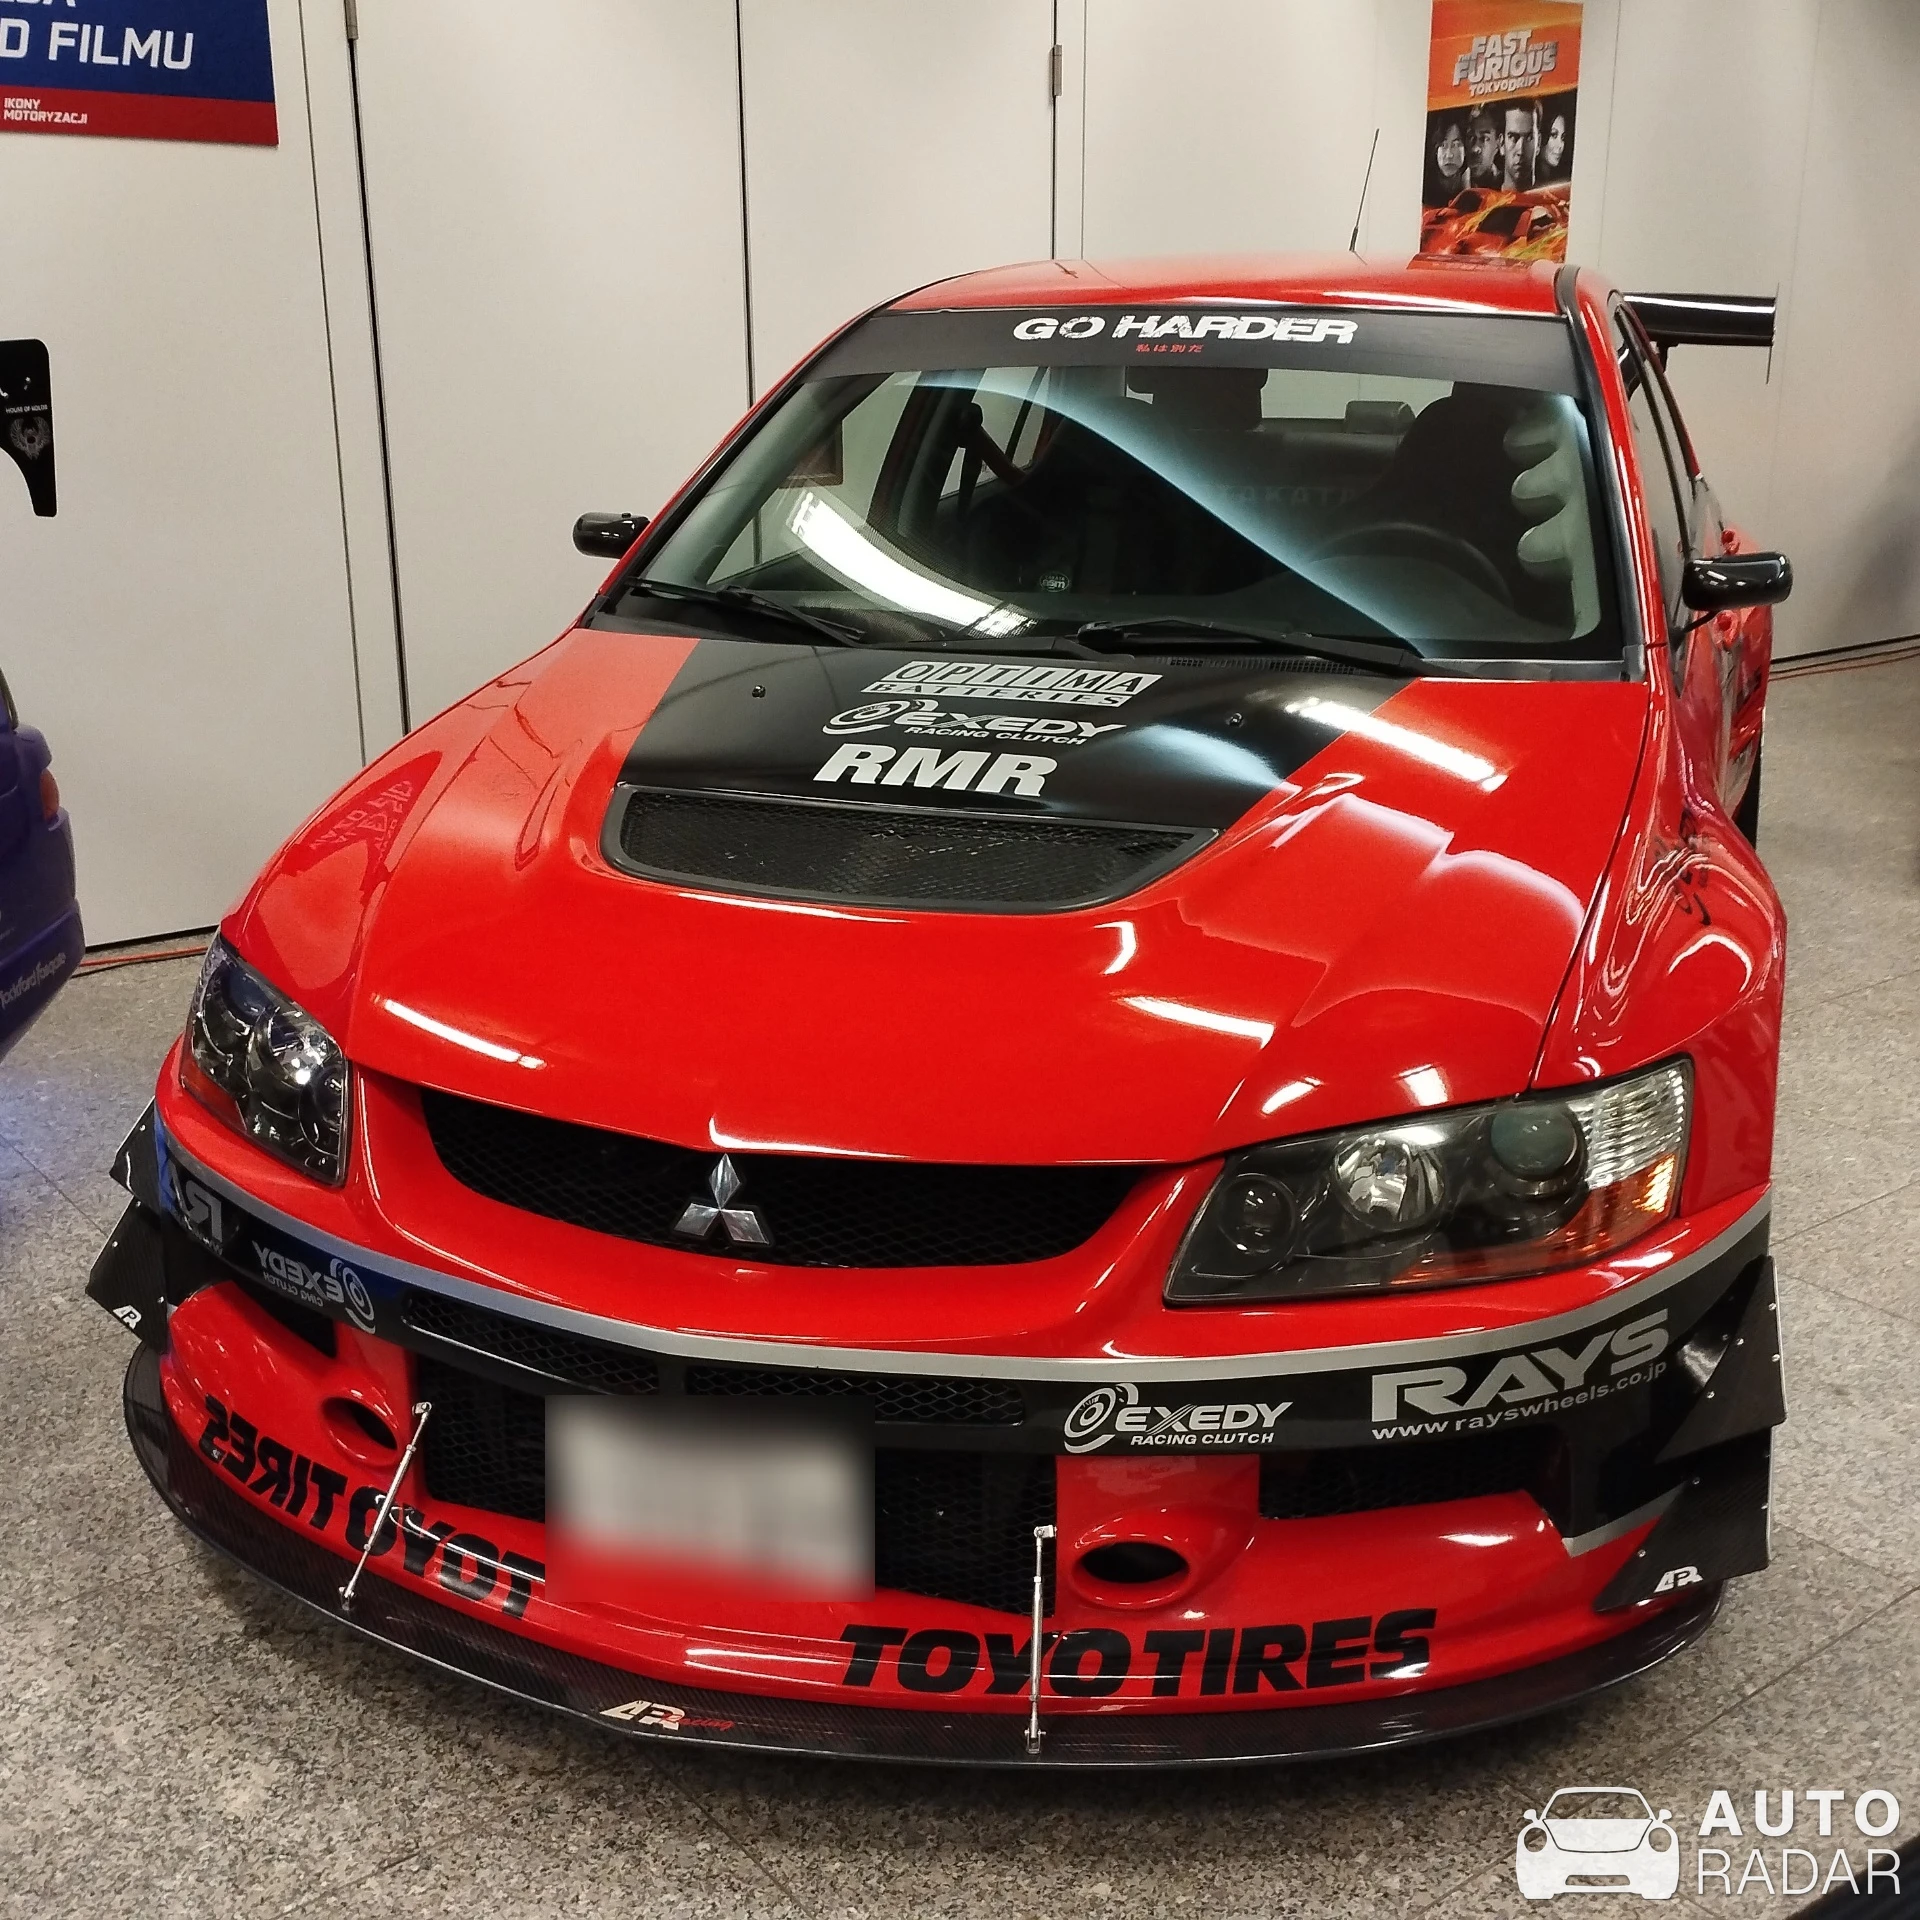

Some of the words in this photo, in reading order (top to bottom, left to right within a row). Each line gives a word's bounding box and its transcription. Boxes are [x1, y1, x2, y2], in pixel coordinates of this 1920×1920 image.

[48, 21, 194, 70] FILMU
[1471, 29, 1533, 58] FAST
[1452, 49, 1557, 87] FURIOUS
[4, 97, 41, 110] IKONY
[4, 110, 88, 124] MOTORYZACJI
[1013, 316, 1106, 340] GO
[1112, 315, 1359, 344] HARDER
[885, 662, 1157, 695] OPTIMA
[863, 682, 1130, 707] BATTERIES
[894, 711, 1127, 738] EXEDY
[904, 726, 989, 738] RACING
[996, 732, 1088, 745] CLUTCH
[813, 743, 1058, 797] RMR
[1371, 1308, 1669, 1422] RAYS
[1115, 1401, 1294, 1434] EXEDY
[1131, 1434, 1197, 1446] RACING
[1202, 1432, 1275, 1444] CLUTCH
[840, 1624, 1132, 1698] TOYO
[1131, 1608, 1437, 1696] TIRES
